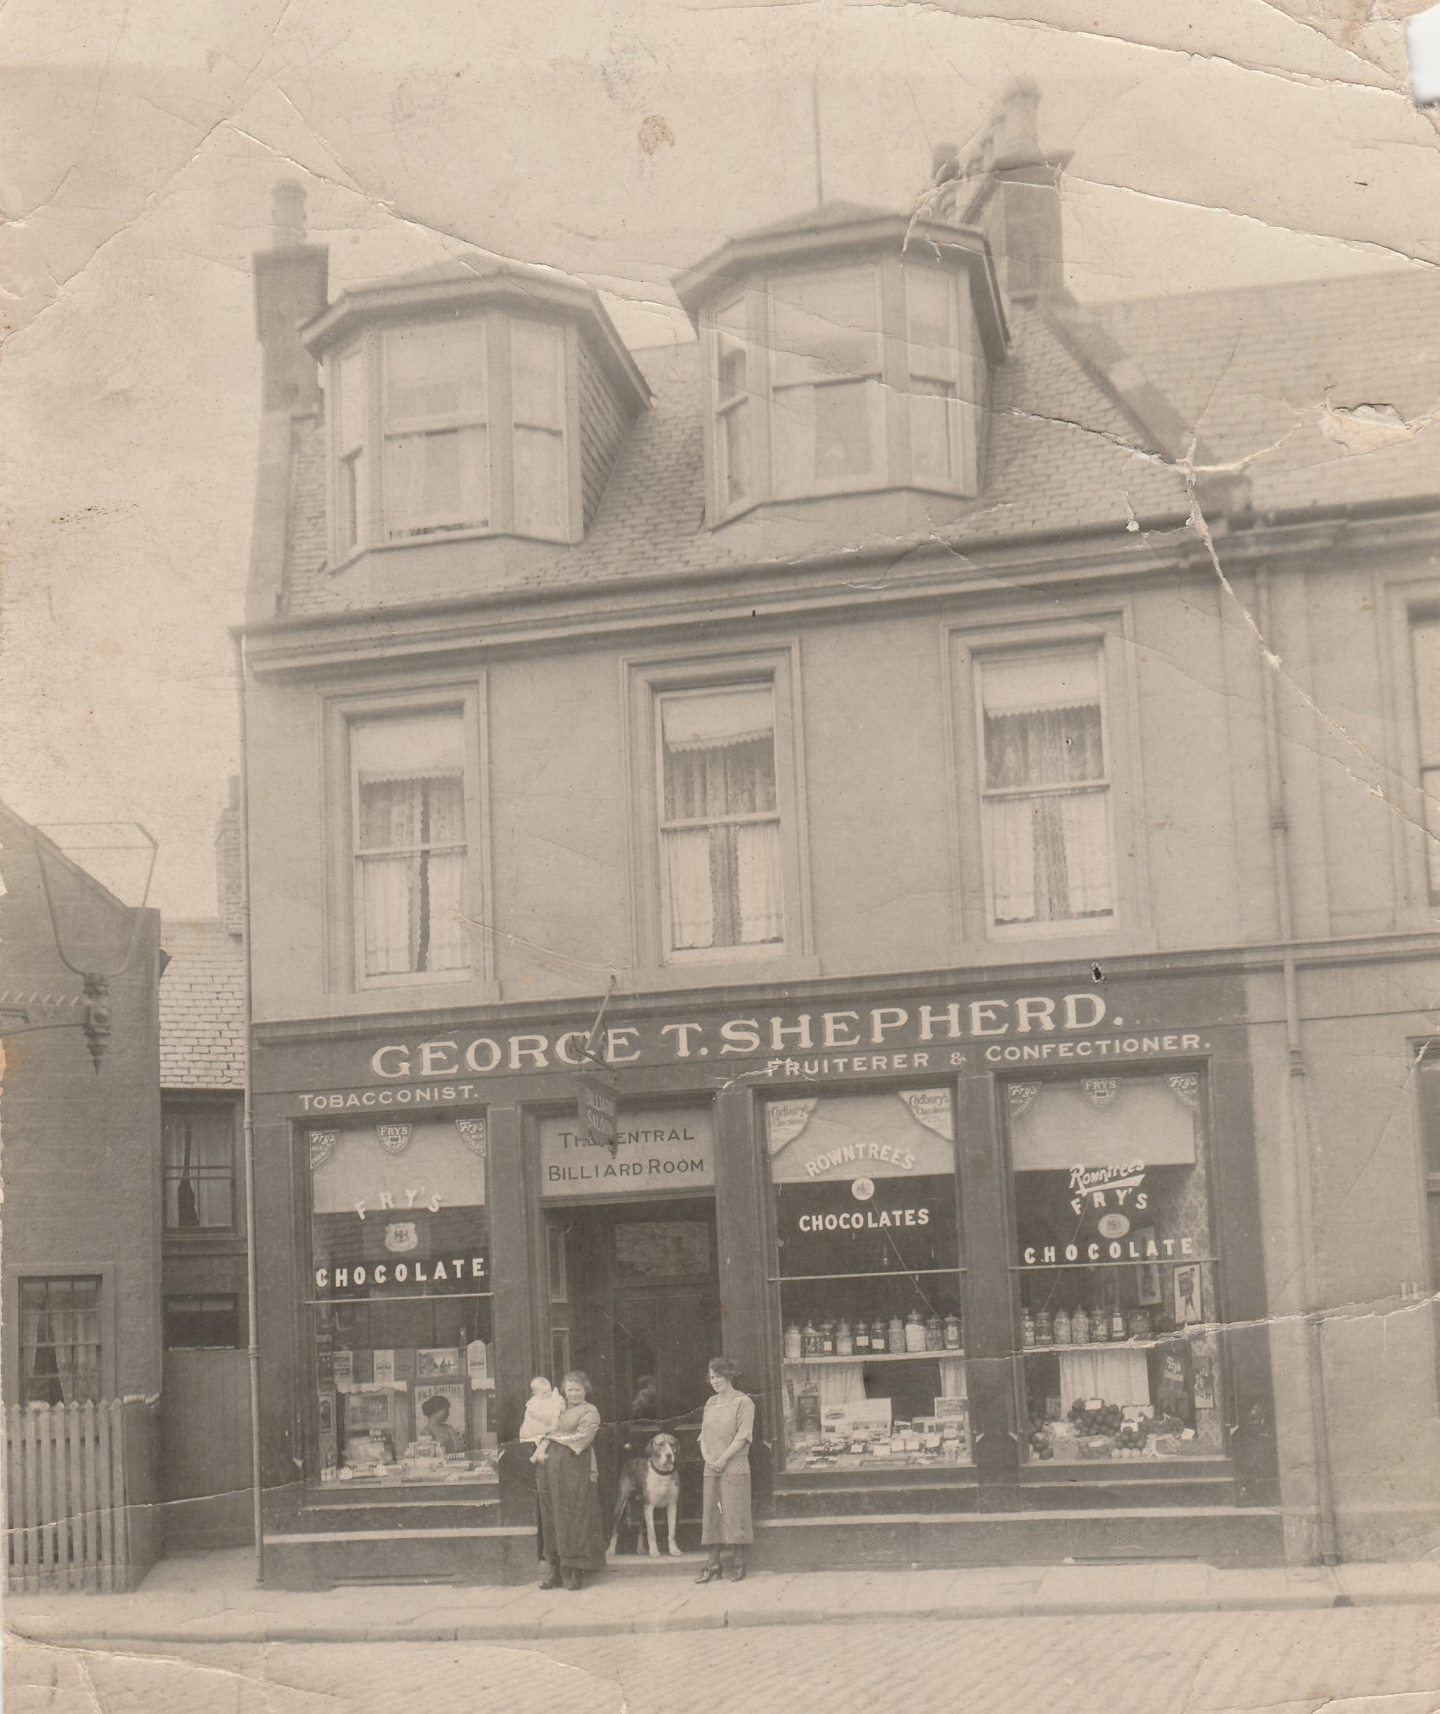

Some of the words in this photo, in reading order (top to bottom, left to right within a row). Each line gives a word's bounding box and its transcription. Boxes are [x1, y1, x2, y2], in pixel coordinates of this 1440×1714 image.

[372, 1026, 640, 1078] GEORGE
[661, 1022, 709, 1058] T.
[720, 992, 1124, 1055] SHEPHERD.
[767, 1052, 930, 1077] FRUITERER
[950, 1050, 967, 1065] &
[985, 1033, 1211, 1063] CONFECTIONER.
[299, 1085, 479, 1110] TOBACCONIST.
[548, 1163, 643, 1182] BILLIARD
[648, 1158, 704, 1175] ROOM
[804, 1142, 915, 1178] ROWNTREE'S
[355, 1187, 443, 1221] FRY'S
[1070, 1187, 1149, 1215] FRY'S
[798, 1208, 930, 1232] CHOCOLATES
[1024, 1237, 1194, 1265] CHOCOLATE
[315, 1257, 485, 1288] CHOCOLATE
